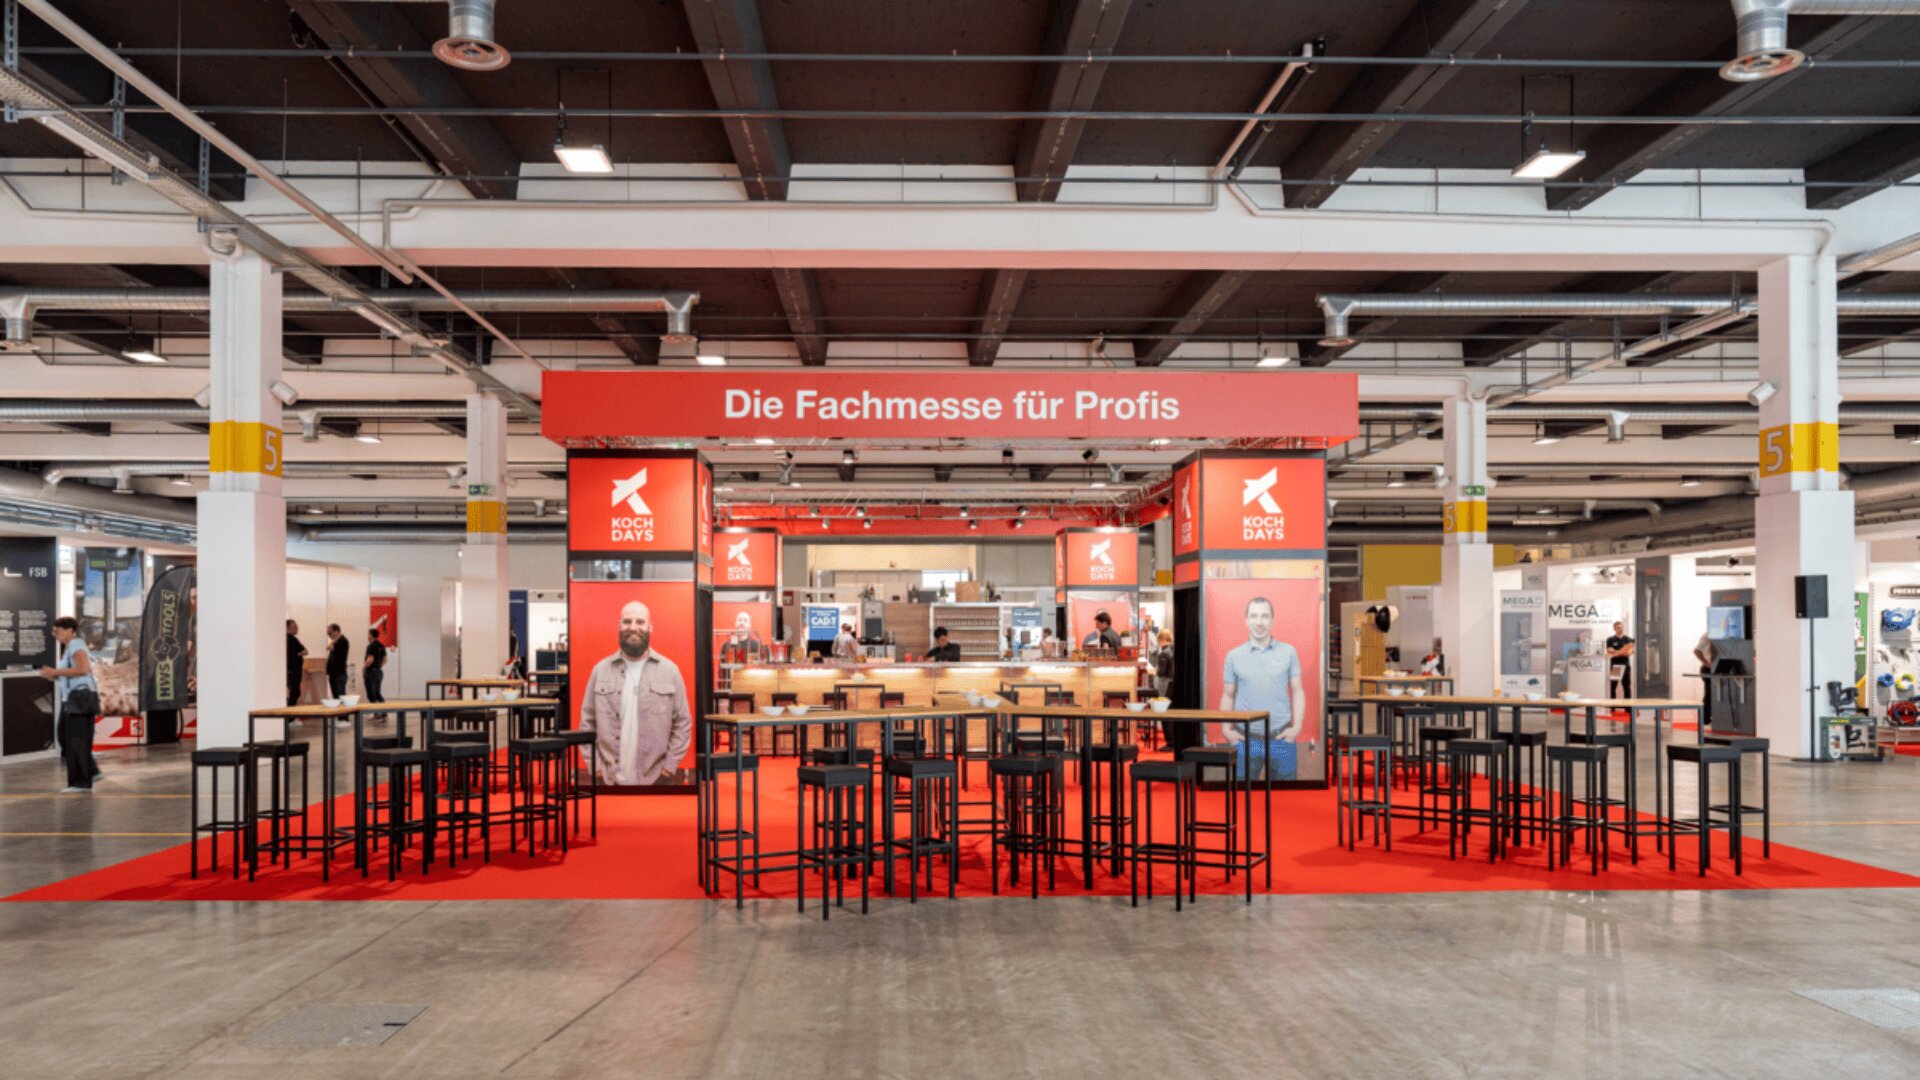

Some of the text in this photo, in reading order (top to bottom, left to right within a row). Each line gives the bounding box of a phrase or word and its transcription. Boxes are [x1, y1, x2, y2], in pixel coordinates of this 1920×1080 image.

[724, 389, 1180, 421] Die Fachmesse für Profis
[265, 430, 277, 471] 5
[1766, 431, 1783, 471] 5
[611, 517, 654, 529] KOCH
[1243, 516, 1284, 528] KOCH
[1445, 504, 1454, 531] 5
[611, 530, 654, 541] DAYS
[1243, 529, 1284, 540] DAYS
[29, 567, 48, 578] FSB
[728, 573, 752, 581] DAYS
[1503, 597, 1534, 605] MEGA
[1549, 604, 1600, 618] MEGA
[159, 592, 176, 697] HWS TOOLS
